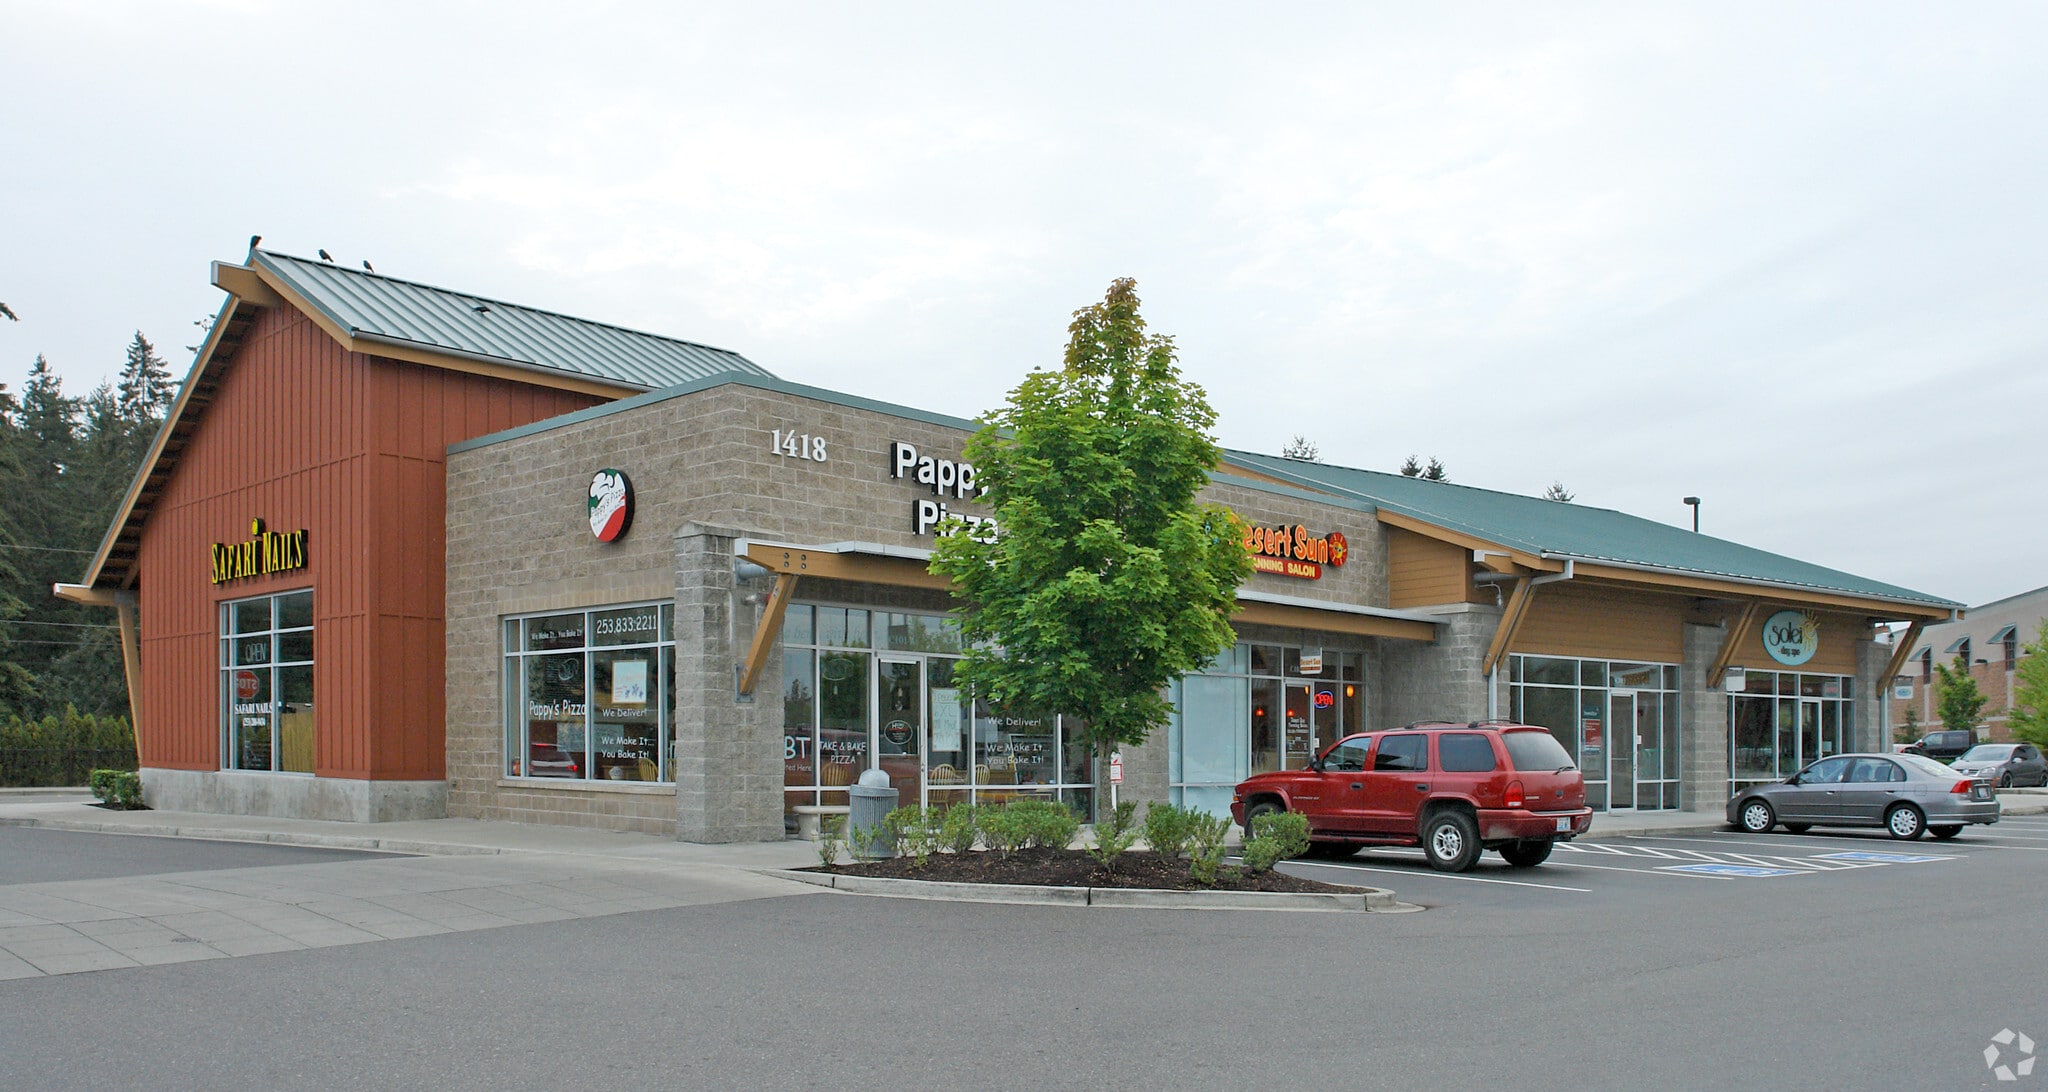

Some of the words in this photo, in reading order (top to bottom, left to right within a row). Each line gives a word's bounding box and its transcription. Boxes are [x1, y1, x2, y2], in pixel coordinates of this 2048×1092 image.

[771, 429, 827, 462] 1418
[1234, 517, 1292, 557] esert
[1294, 524, 1328, 564] Sun
[211, 540, 259, 584] SAFARI
[262, 530, 304, 574] NAILS
[1247, 555, 1284, 573] ANNING
[1287, 563, 1316, 578] SALON
[596, 615, 657, 634] 253.833.2211
[245, 642, 266, 663] OPEN
[1314, 693, 1334, 706] OPEN
[235, 703, 254, 714] SAFARI
[529, 699, 560, 720] Pappy's
[562, 699, 587, 716] Pizza
[602, 708, 615, 718] We
[617, 708, 648, 718] Deliver!
[988, 717, 1003, 726] We
[1006, 717, 1042, 727] Deliver!
[601, 736, 614, 747] We
[616, 736, 638, 746] Make
[819, 740, 838, 751] TAKE
[838, 741, 846, 751] &
[847, 741, 867, 752] BAKE
[602, 749, 615, 759] You
[617, 750, 637, 759] Bake
[987, 743, 1003, 753] We
[1006, 743, 1030, 752] Make
[830, 754, 856, 765] PIZZA
[1007, 755, 1029, 765] Bake
